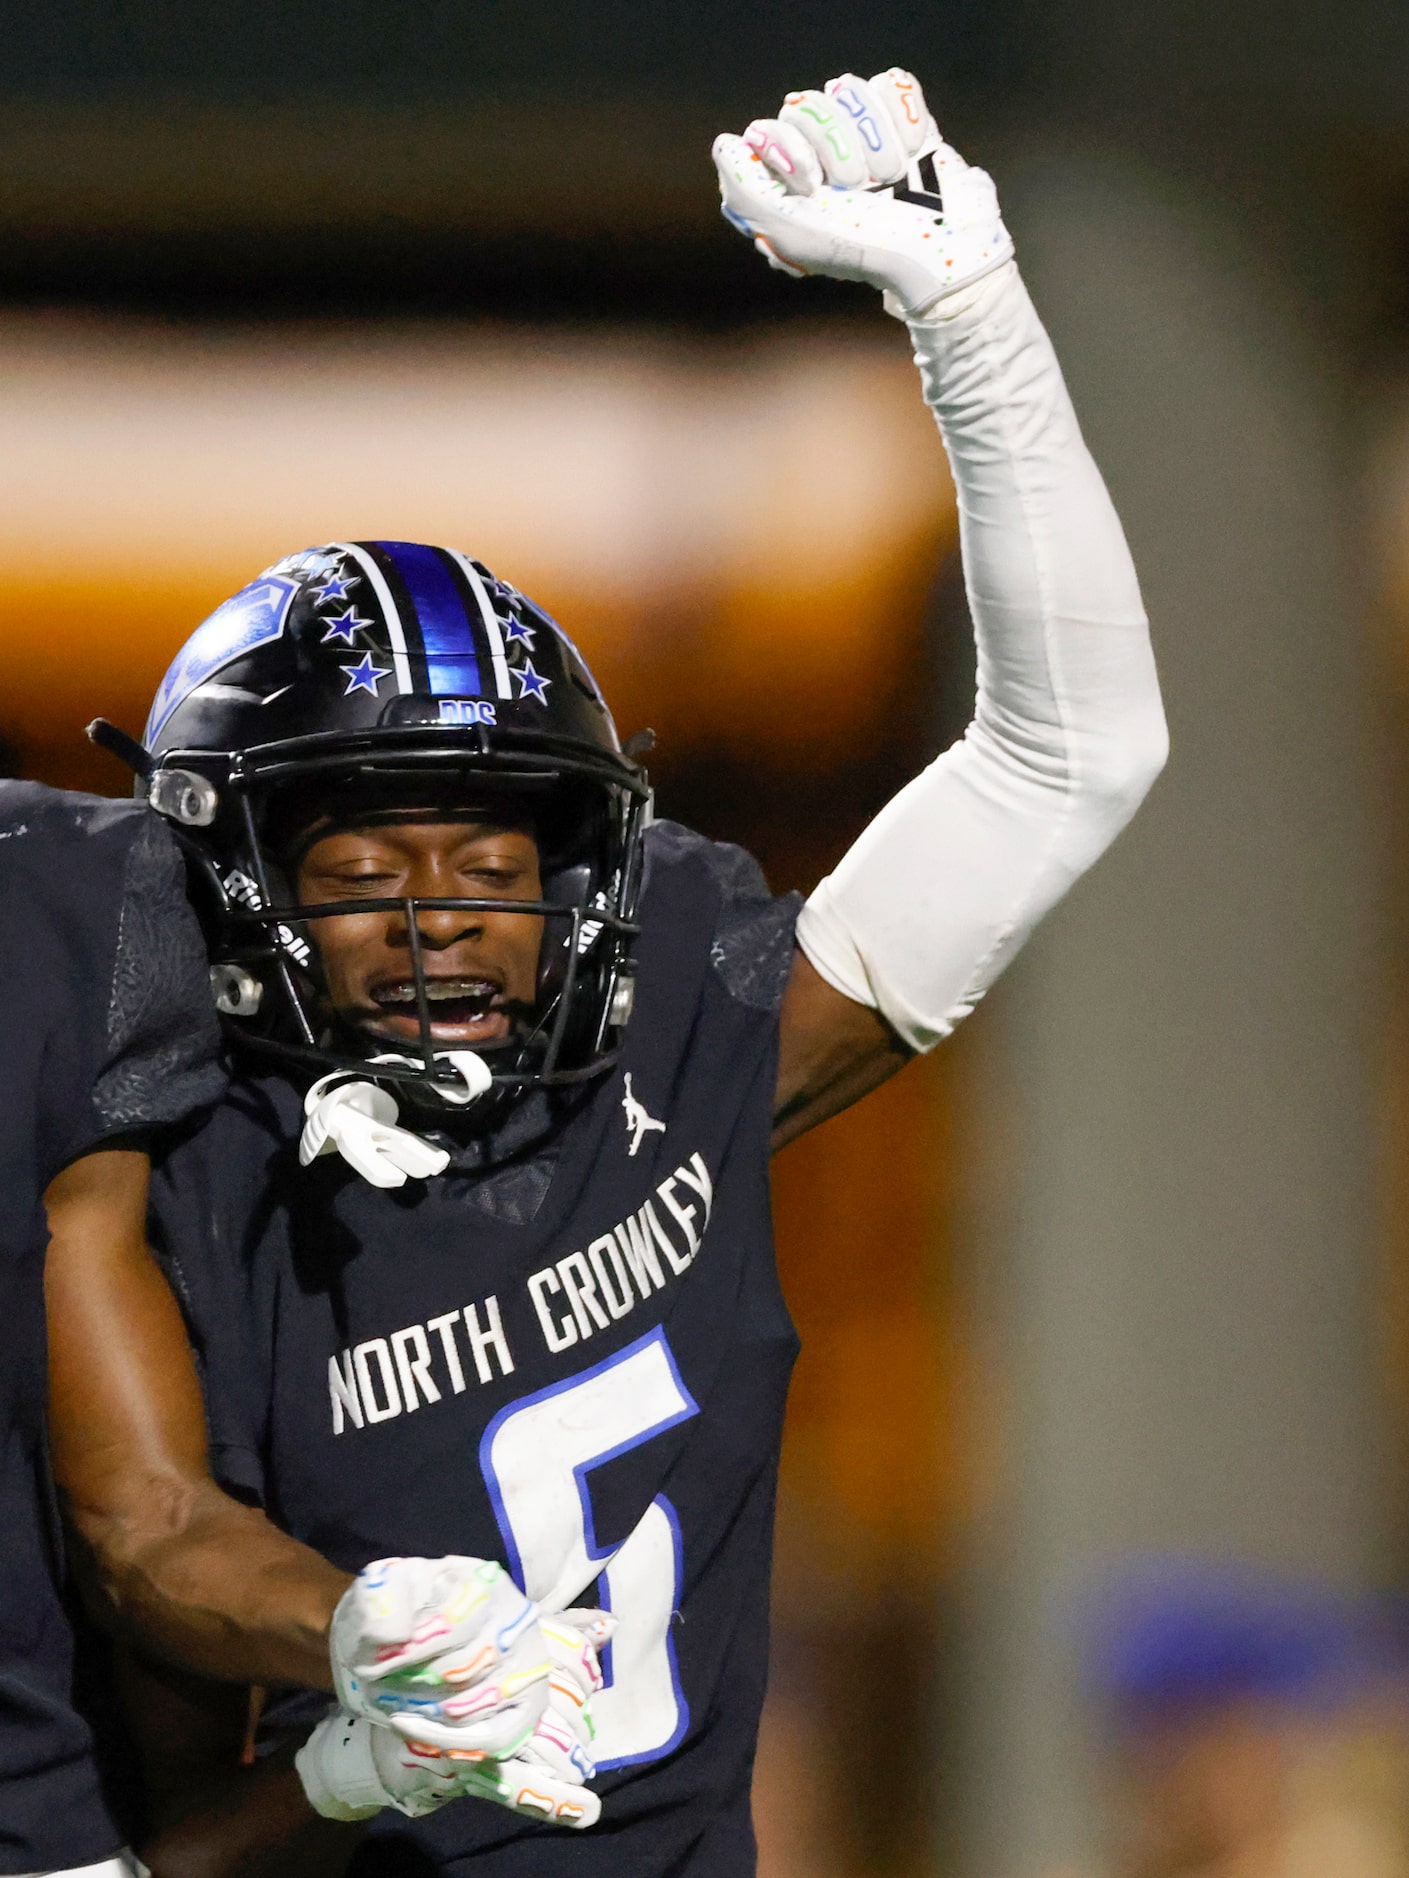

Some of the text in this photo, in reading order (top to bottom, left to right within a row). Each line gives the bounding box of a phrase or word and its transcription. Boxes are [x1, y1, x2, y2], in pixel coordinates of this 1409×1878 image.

[222, 869, 311, 967] Ridell
[327, 1152, 713, 1435] NORTH CROWLEY
